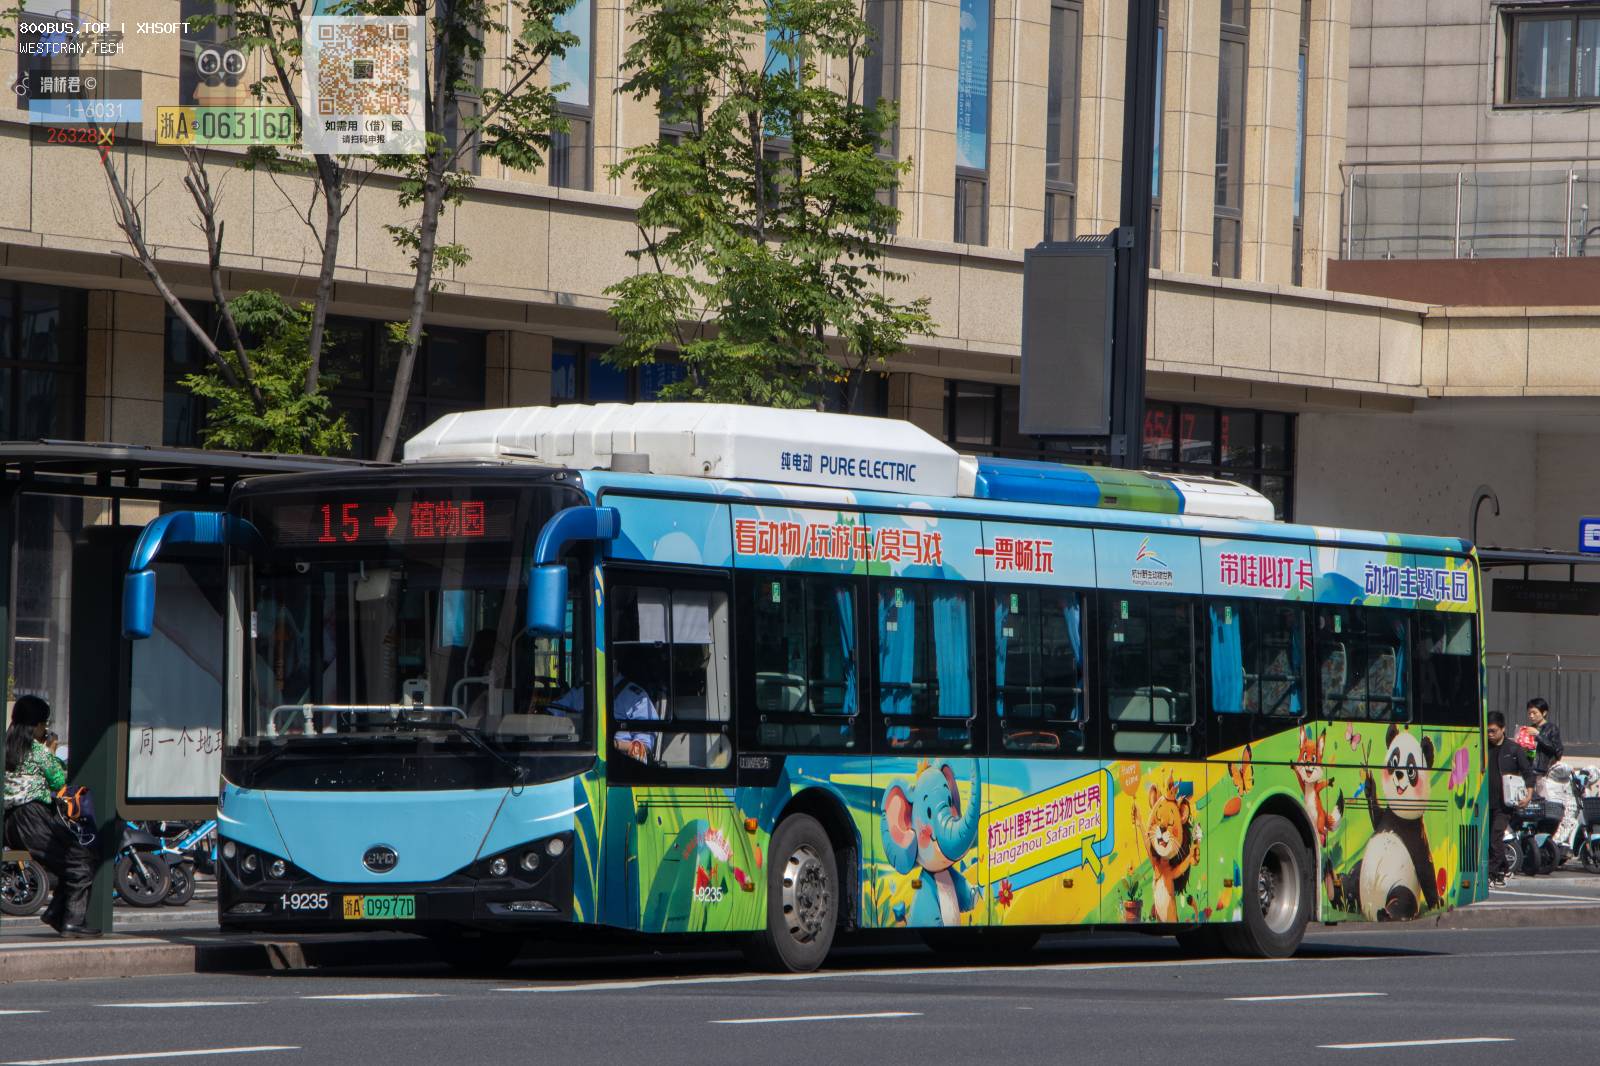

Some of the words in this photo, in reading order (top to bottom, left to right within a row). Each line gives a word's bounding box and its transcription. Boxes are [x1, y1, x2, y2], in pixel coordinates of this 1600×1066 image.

[781, 451, 813, 473] 纯电动
[820, 455, 856, 477] PURE
[859, 458, 916, 482] ELECTRIC
[319, 503, 359, 543] 15
[410, 500, 485, 537] 植物园
[735, 519, 942, 566] 看动物/玩游乐/赏马戏
[974, 537, 1054, 573] 一票畅玩
[1220, 552, 1313, 591] 带娃必打卡
[1364, 560, 1469, 602] 动物主题乐园
[987, 784, 1101, 849] 杭州野生动物世界
[988, 836, 1042, 866] Hangzhou
[1046, 821, 1075, 845] Safari
[1078, 813, 1101, 833] Park
[280, 893, 329, 910] 1-9235
